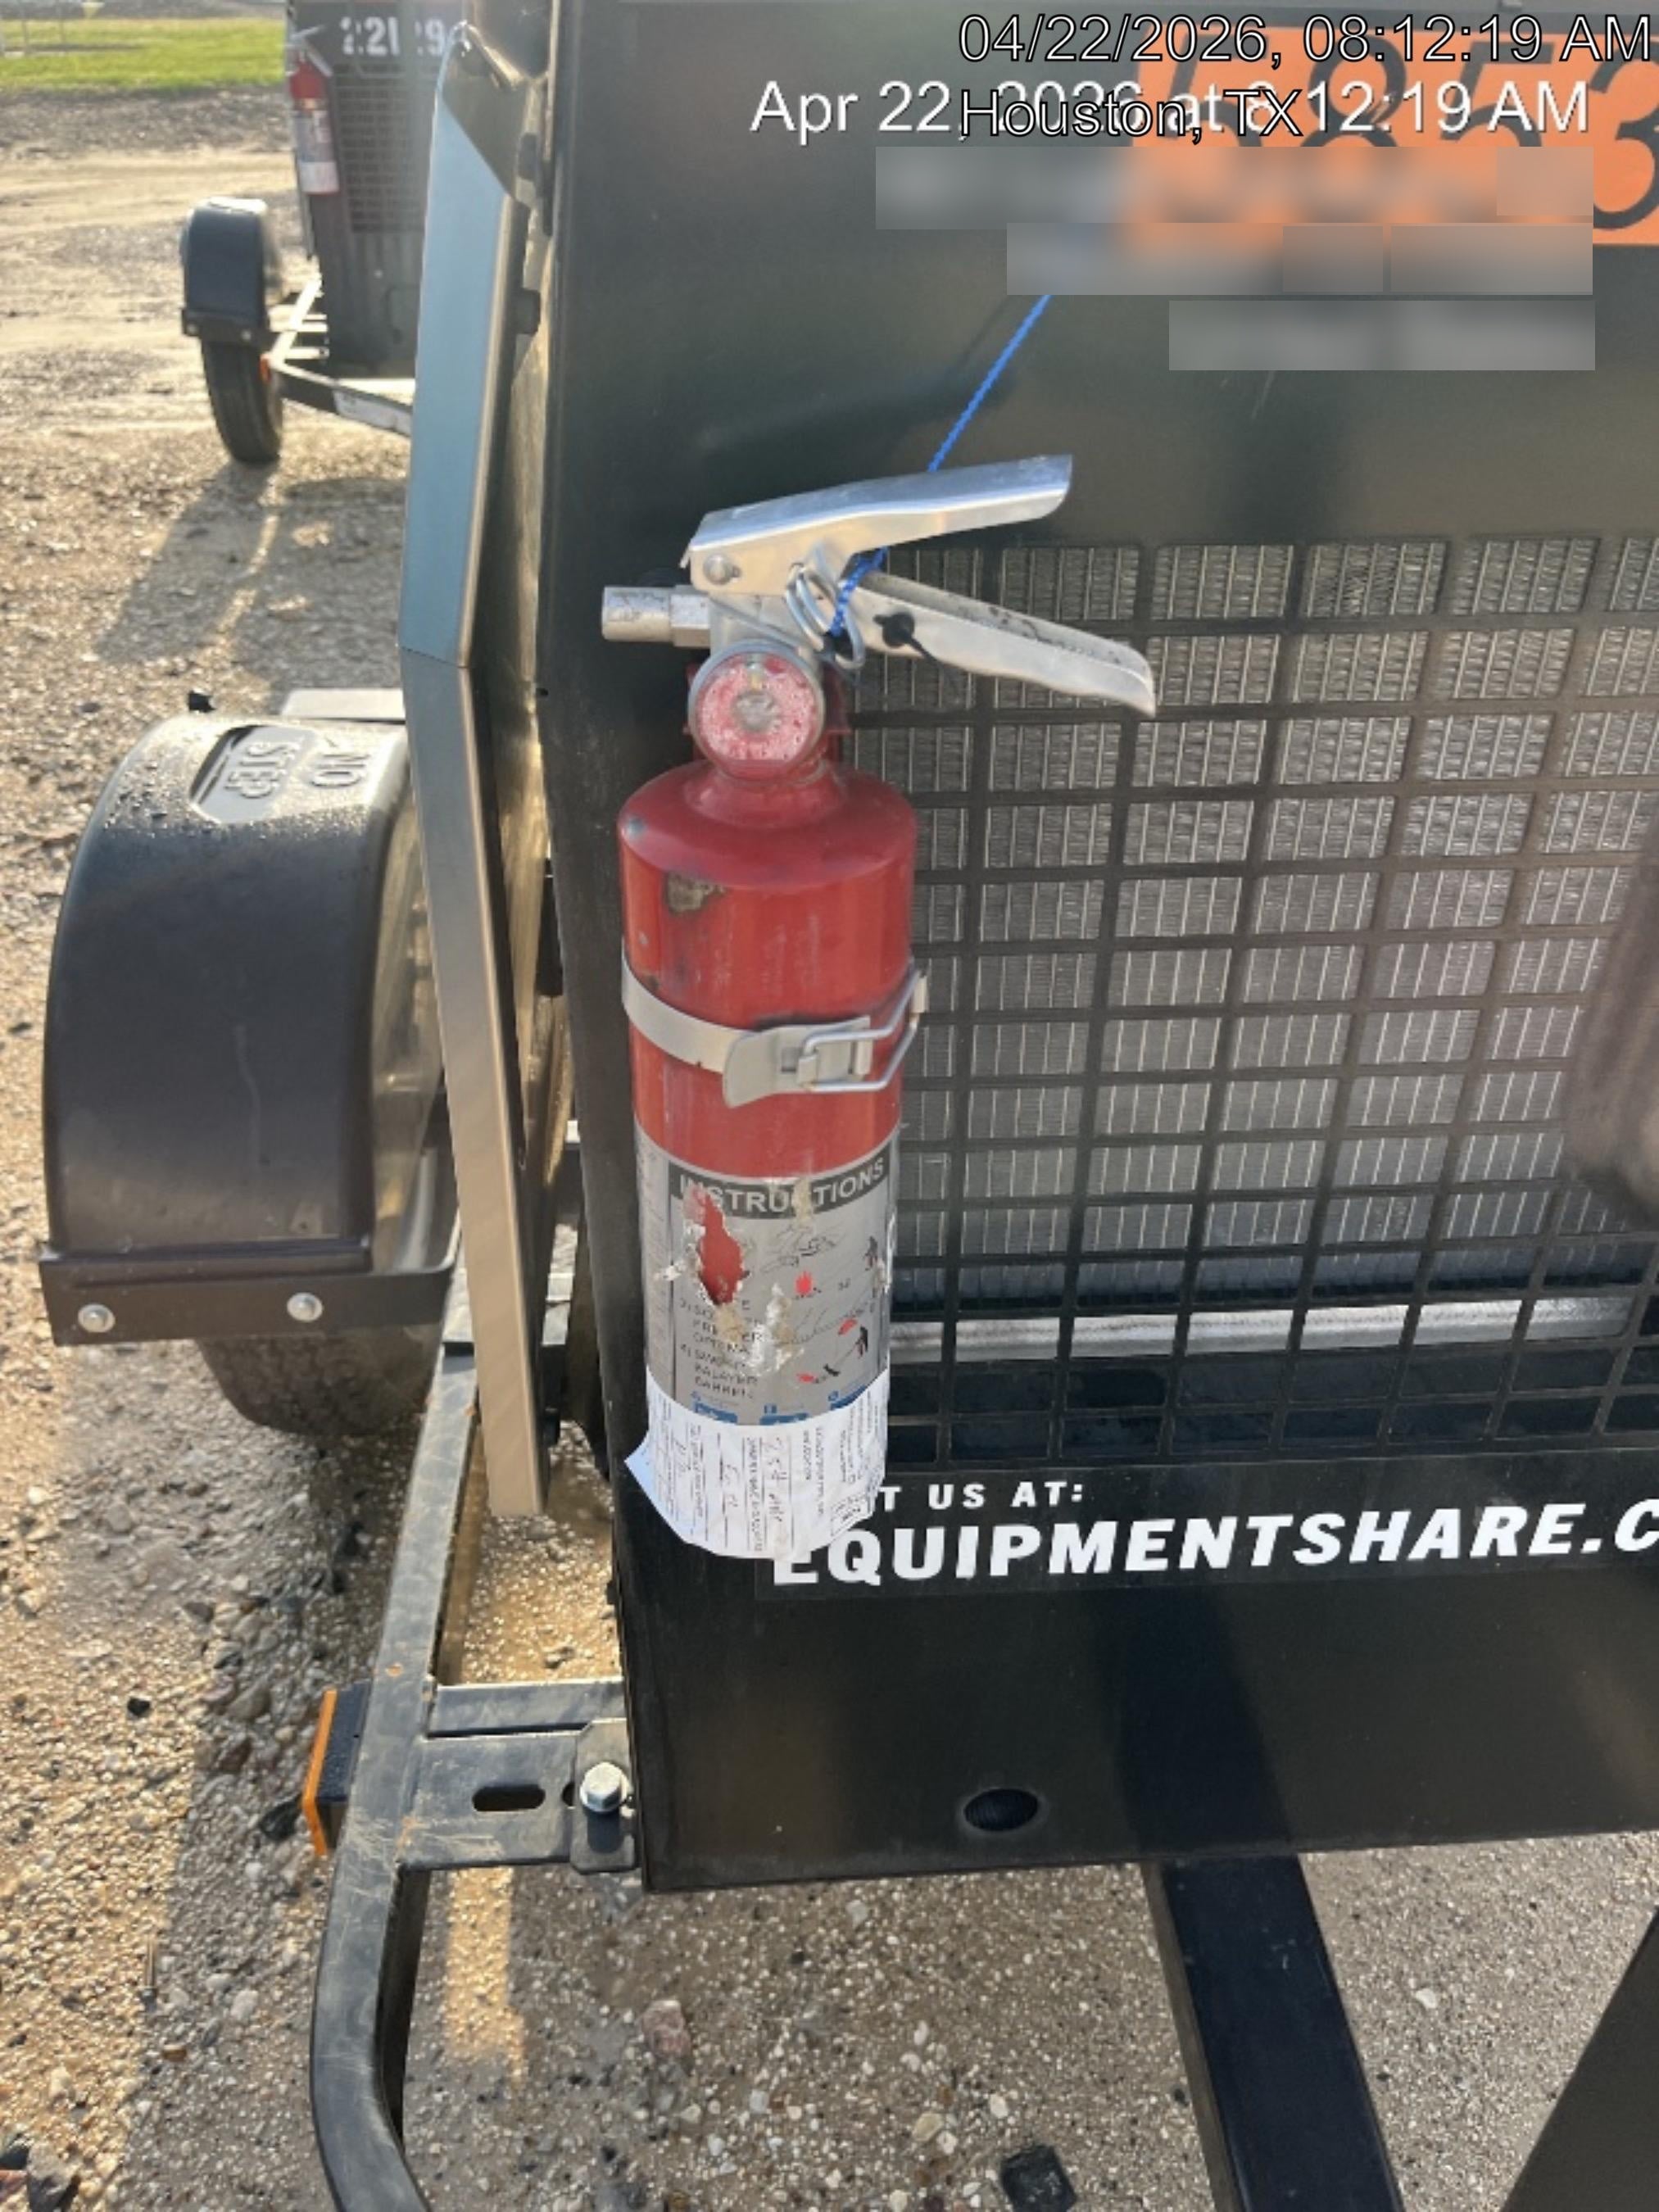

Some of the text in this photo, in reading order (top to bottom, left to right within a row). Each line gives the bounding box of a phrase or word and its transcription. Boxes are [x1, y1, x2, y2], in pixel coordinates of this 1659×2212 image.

[224, 741, 301, 800] STEP
[311, 750, 371, 788] NO
[927, 1484, 986, 1510] US
[1009, 1480, 1083, 1508] AT:
